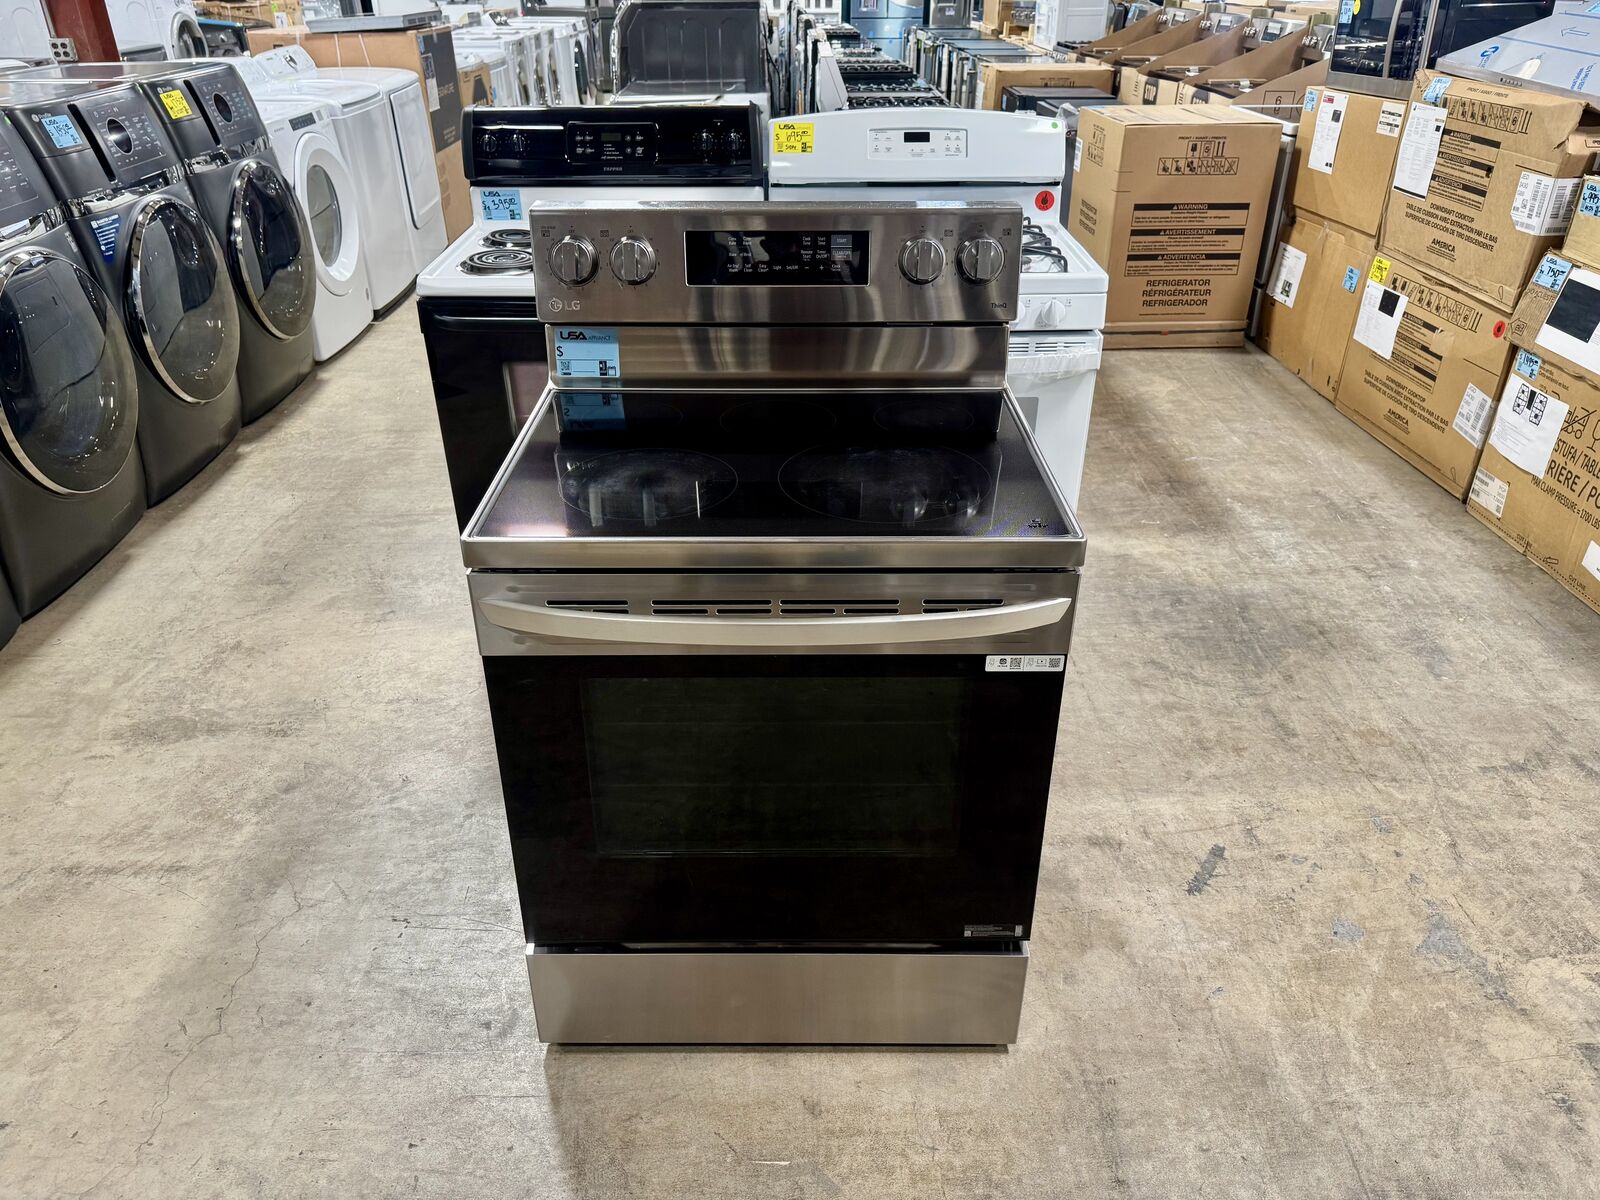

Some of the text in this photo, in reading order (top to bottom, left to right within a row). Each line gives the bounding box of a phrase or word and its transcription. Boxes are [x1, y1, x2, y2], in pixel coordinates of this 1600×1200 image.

[1430, 202, 1474, 224] DOWNDRAFT COOKTOP
[1405, 211, 1425, 225] SUPERFICIE
[1431, 221, 1449, 234] COCCIÓN
[1456, 231, 1464, 240] TIRO
[1464, 234, 1495, 252] DESCENDENTE
[1406, 202, 1416, 211] TABLE
[1422, 208, 1439, 220] CUISSON
[1439, 214, 1450, 224] AVEC
[1450, 219, 1475, 234] EXTRACTION
[1474, 228, 1483, 237] PAR
[1483, 232, 1489, 240] LE
[1489, 234, 1498, 244] BAS
[1432, 238, 1455, 253] AMERICA
[1546, 256, 1557, 265] USA
[1146, 279, 1211, 287] REFRIGERATOR
[1142, 288, 1212, 297] RÉFRIGÉRATEUR
[564, 300, 580, 310] LG
[1142, 299, 1208, 307] REFRIGERADOR
[560, 331, 587, 340] USA
[557, 346, 563, 357] $
[1386, 375, 1426, 402] DOWNDRAFT COOKTOP
[1364, 377, 1382, 393] SUPERFICIE
[1403, 403, 1409, 411] DE
[1408, 406, 1418, 416] TIRO
[1417, 412, 1446, 434] DESCENDENTE
[1365, 369, 1374, 380] TABLE
[1379, 379, 1394, 392] CUISSON
[1394, 387, 1404, 398] AVEC
[1403, 394, 1426, 412] EXTRACTION
[1426, 407, 1435, 417] PAR
[1434, 413, 1440, 421] LE
[1440, 417, 1449, 427] BAS
[1388, 408, 1409, 426] AMERICA
[1554, 438, 1577, 464] STUFA
[1546, 459, 1580, 493] RIÈRE
[1531, 474, 1541, 488] MAX
[1540, 481, 1556, 498] CLAMP
[1555, 491, 1577, 513] PRESSURE
[1580, 508, 1592, 523] 1700
[1591, 517, 1600, 529] LBS
[1569, 575, 1586, 591] CUT LINE
